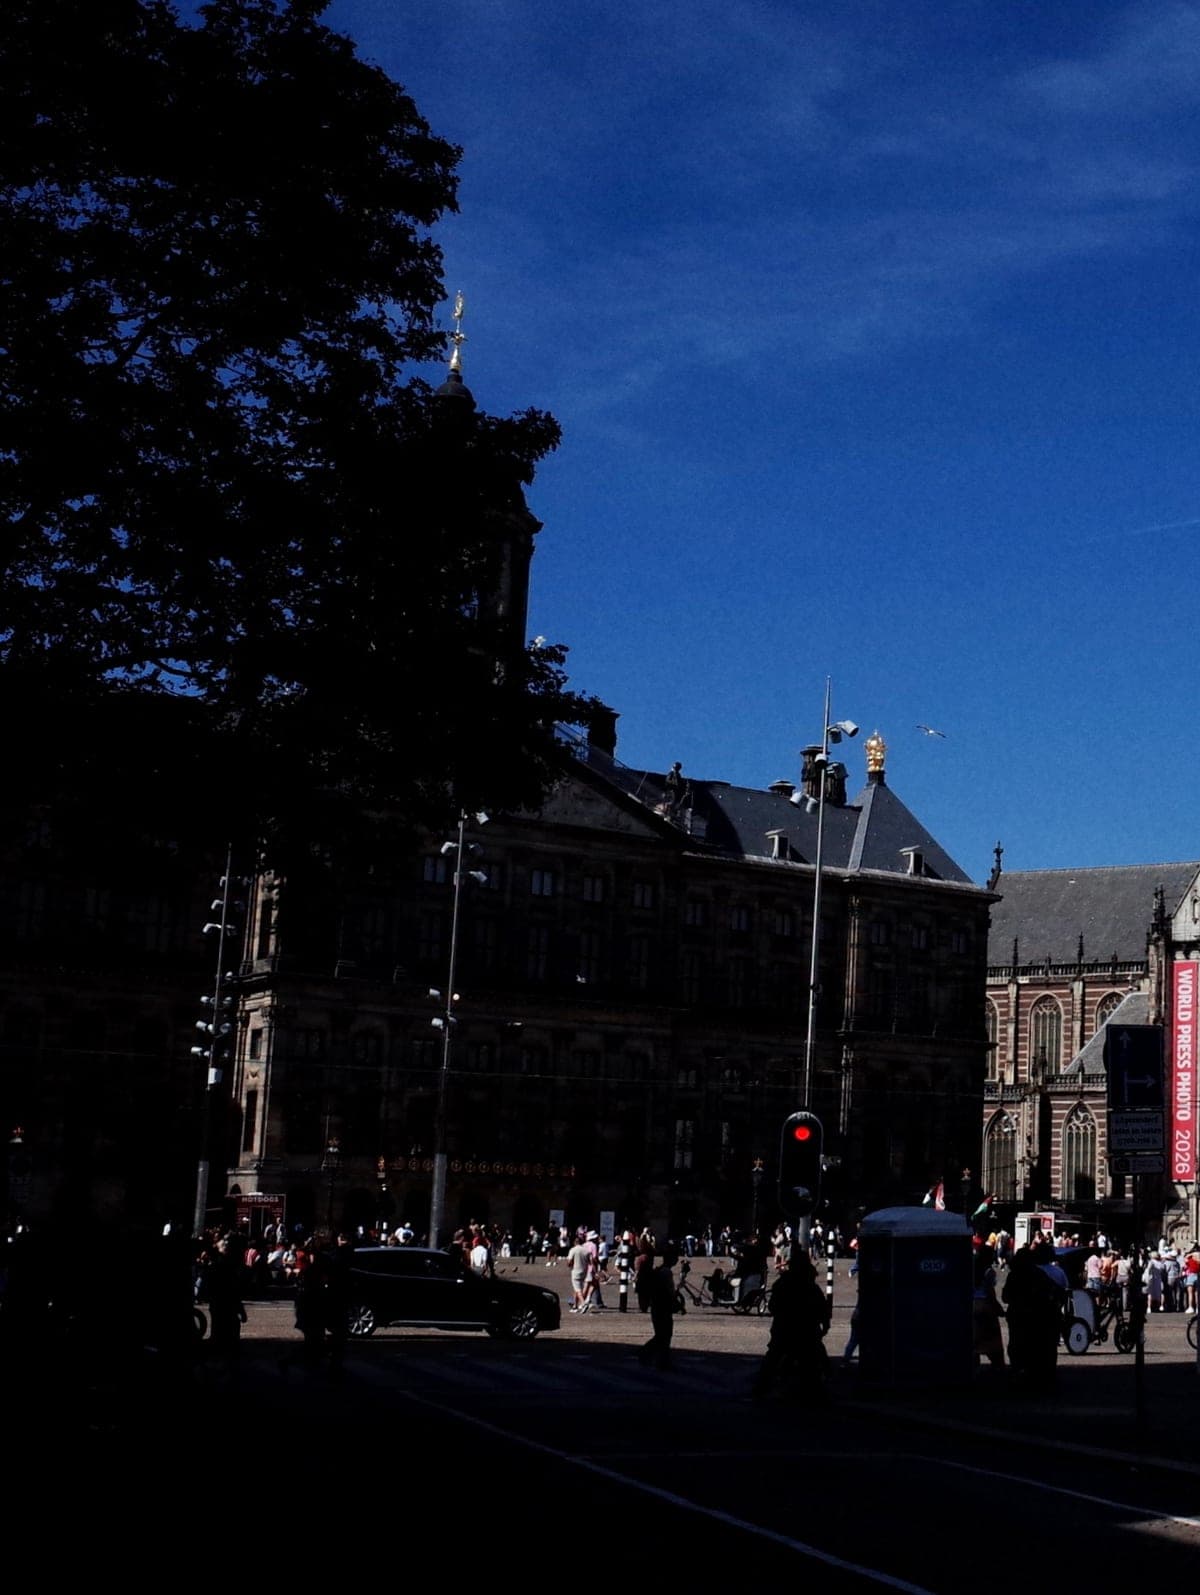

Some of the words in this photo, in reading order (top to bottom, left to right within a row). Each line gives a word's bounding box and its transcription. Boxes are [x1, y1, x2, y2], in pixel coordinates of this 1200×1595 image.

[1177, 969, 1193, 1021] WORLD
[1177, 1024, 1192, 1069] PRESS
[1176, 1072, 1191, 1120] PHOTO
[1175, 1129, 1190, 1174] 2026
